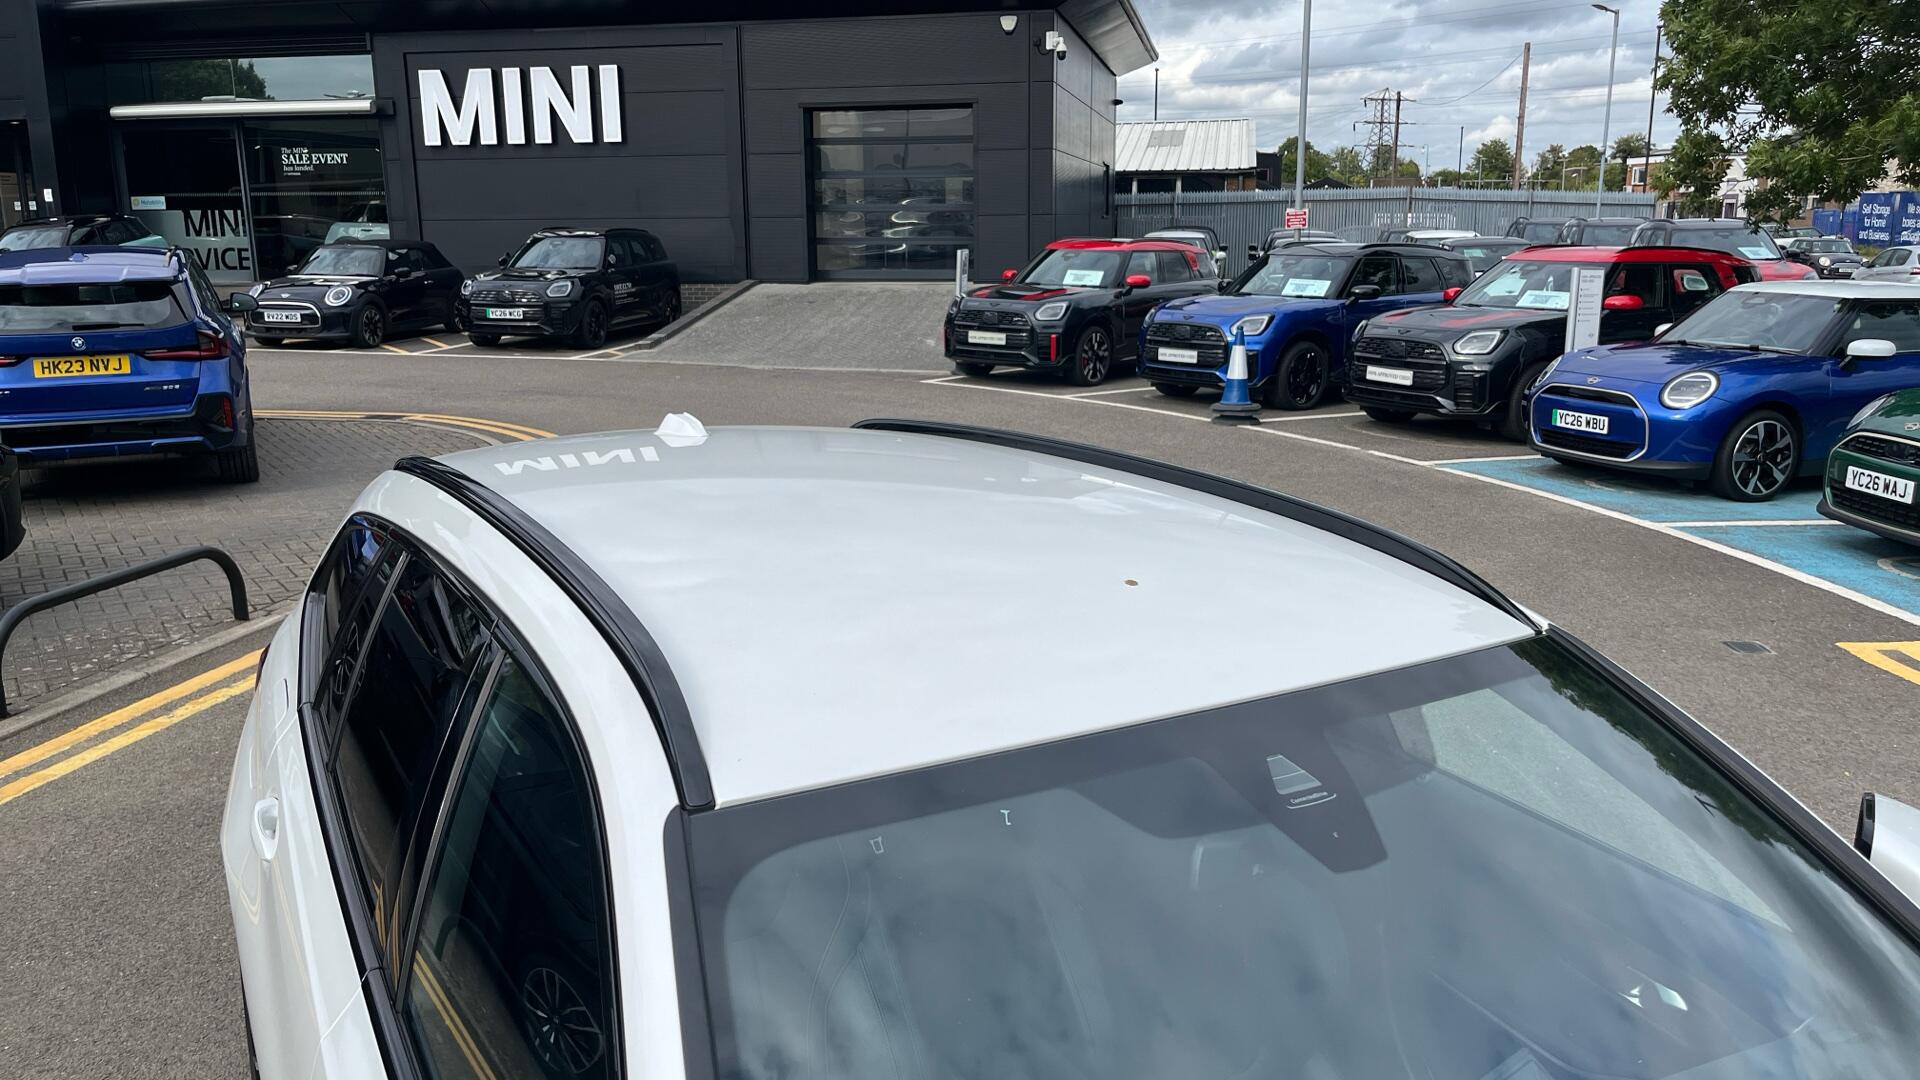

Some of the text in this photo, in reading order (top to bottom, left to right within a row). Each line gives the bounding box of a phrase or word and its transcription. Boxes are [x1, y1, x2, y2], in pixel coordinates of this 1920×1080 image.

[418, 64, 622, 146] MINI
[281, 152, 348, 165] SALE EVENT
[1862, 203, 1890, 217] Self Storage
[181, 209, 248, 237] MINI
[1871, 216, 1886, 227] Home
[1858, 229, 1889, 240] and Business
[40, 359, 122, 374] HK23 NVJ
[1559, 411, 1606, 431] YC26 WBU
[1852, 469, 1908, 499] YC26 WAJ
